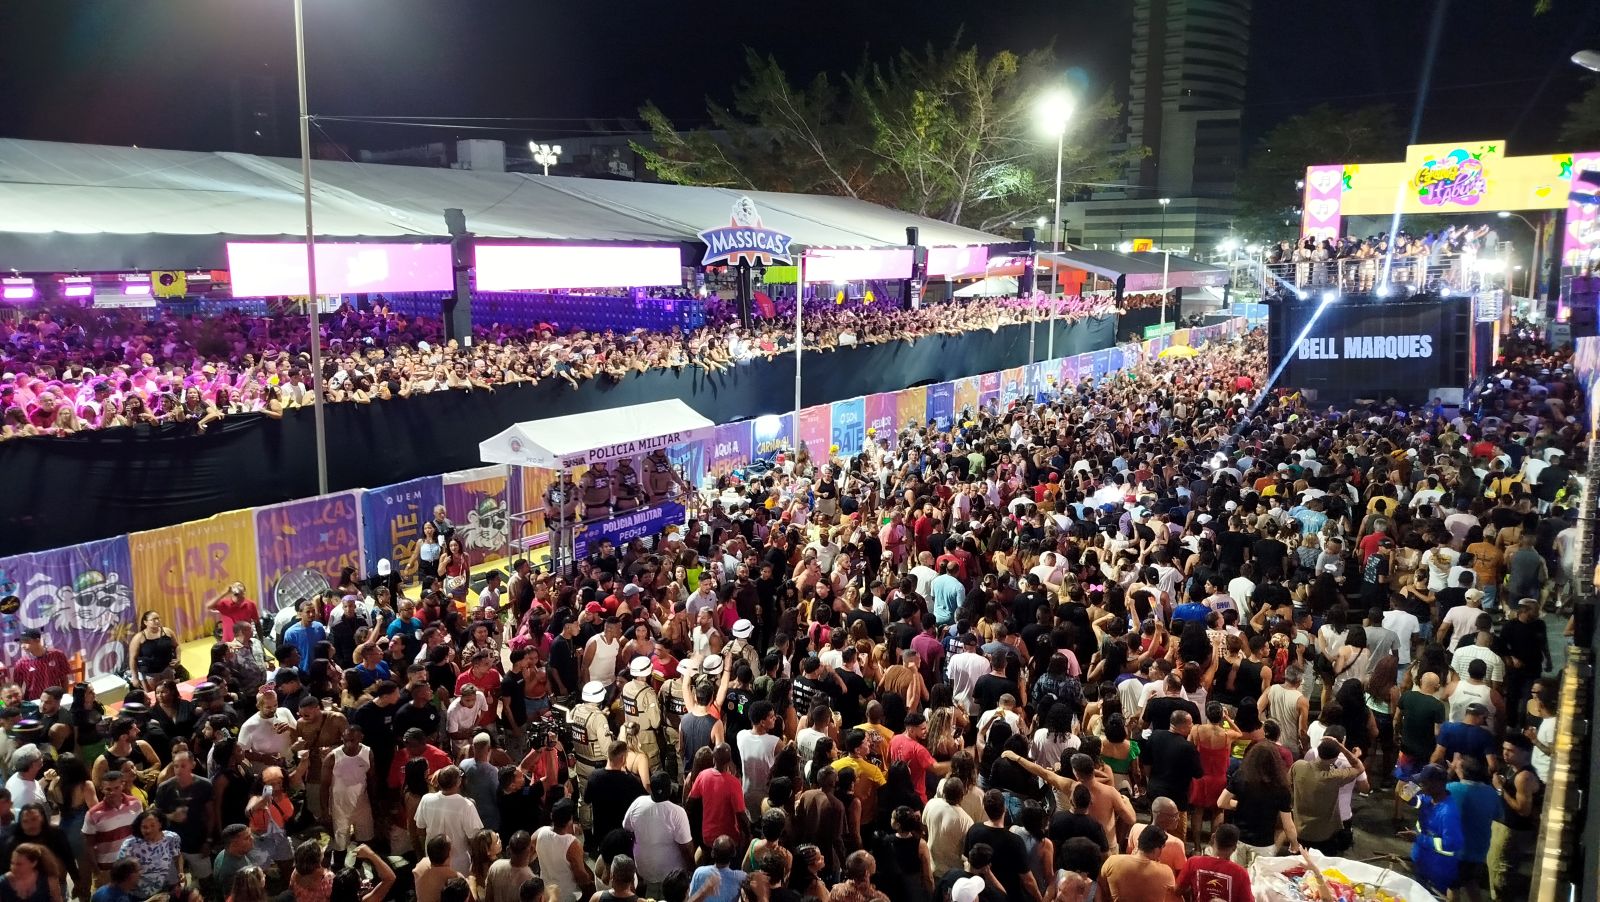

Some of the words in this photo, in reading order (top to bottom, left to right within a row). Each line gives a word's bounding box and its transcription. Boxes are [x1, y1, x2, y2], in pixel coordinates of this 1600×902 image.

[712, 230, 784, 254] MASSICAS
[1299, 337, 1339, 360] BELL
[1344, 335, 1433, 360] MARQUES
[638, 432, 681, 451] MILITAR
[832, 421, 864, 453] BATE
[386, 491, 422, 505] QUEM
[633, 507, 663, 526] MILITAR
[619, 525, 647, 541] PEO-19
[159, 541, 231, 598] CAR
